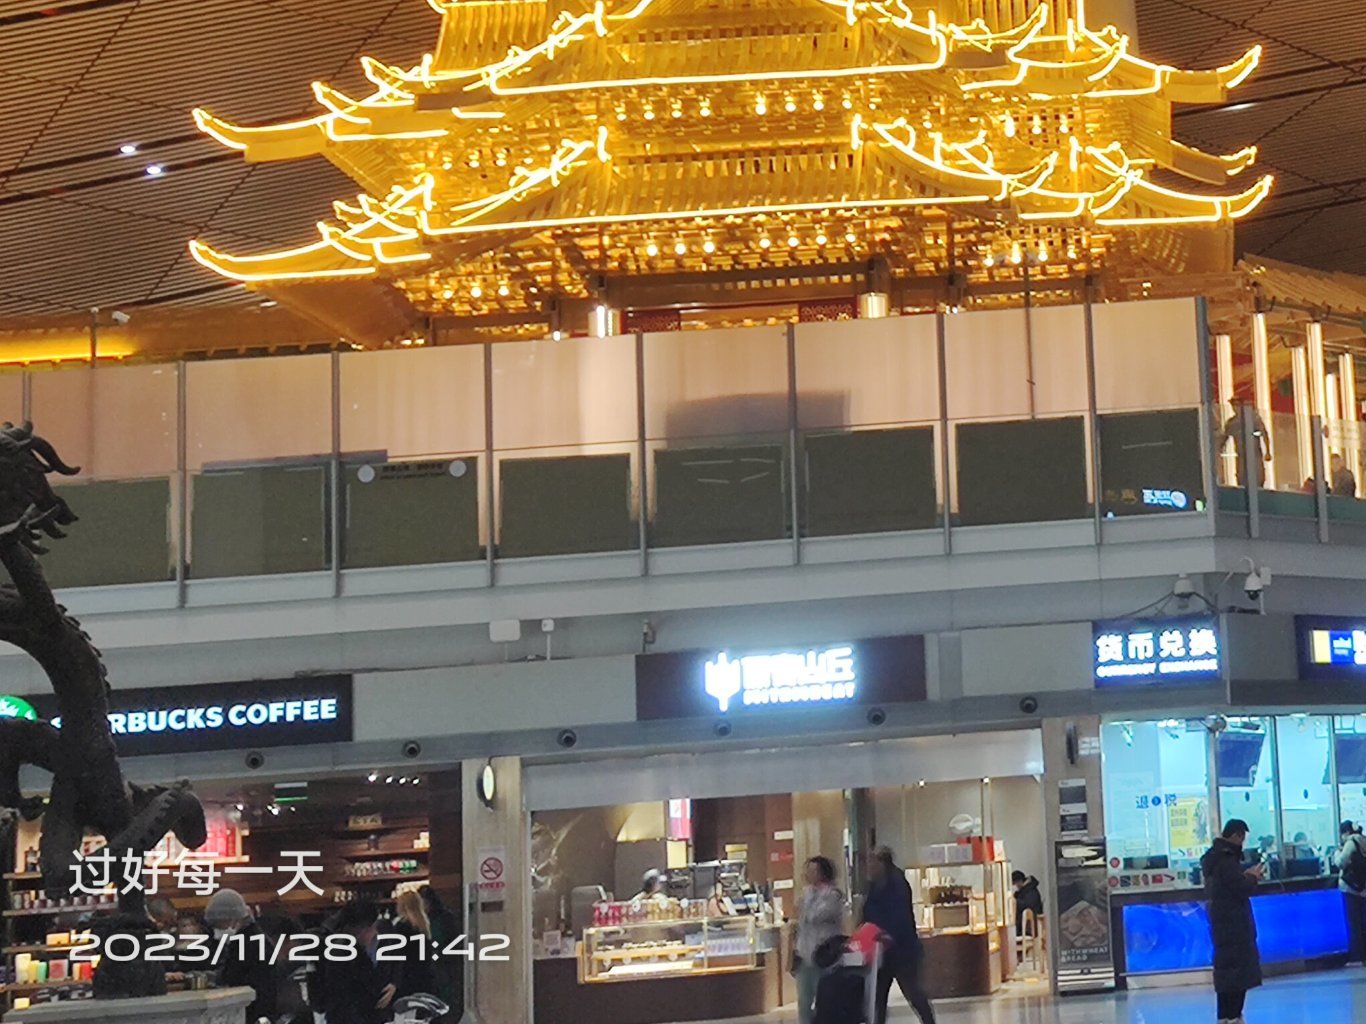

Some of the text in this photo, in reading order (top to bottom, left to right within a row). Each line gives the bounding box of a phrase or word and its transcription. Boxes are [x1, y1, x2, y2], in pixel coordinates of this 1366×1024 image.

[1096, 628, 1217, 662] 货币兑换
[228, 699, 337, 726] COFFEE
